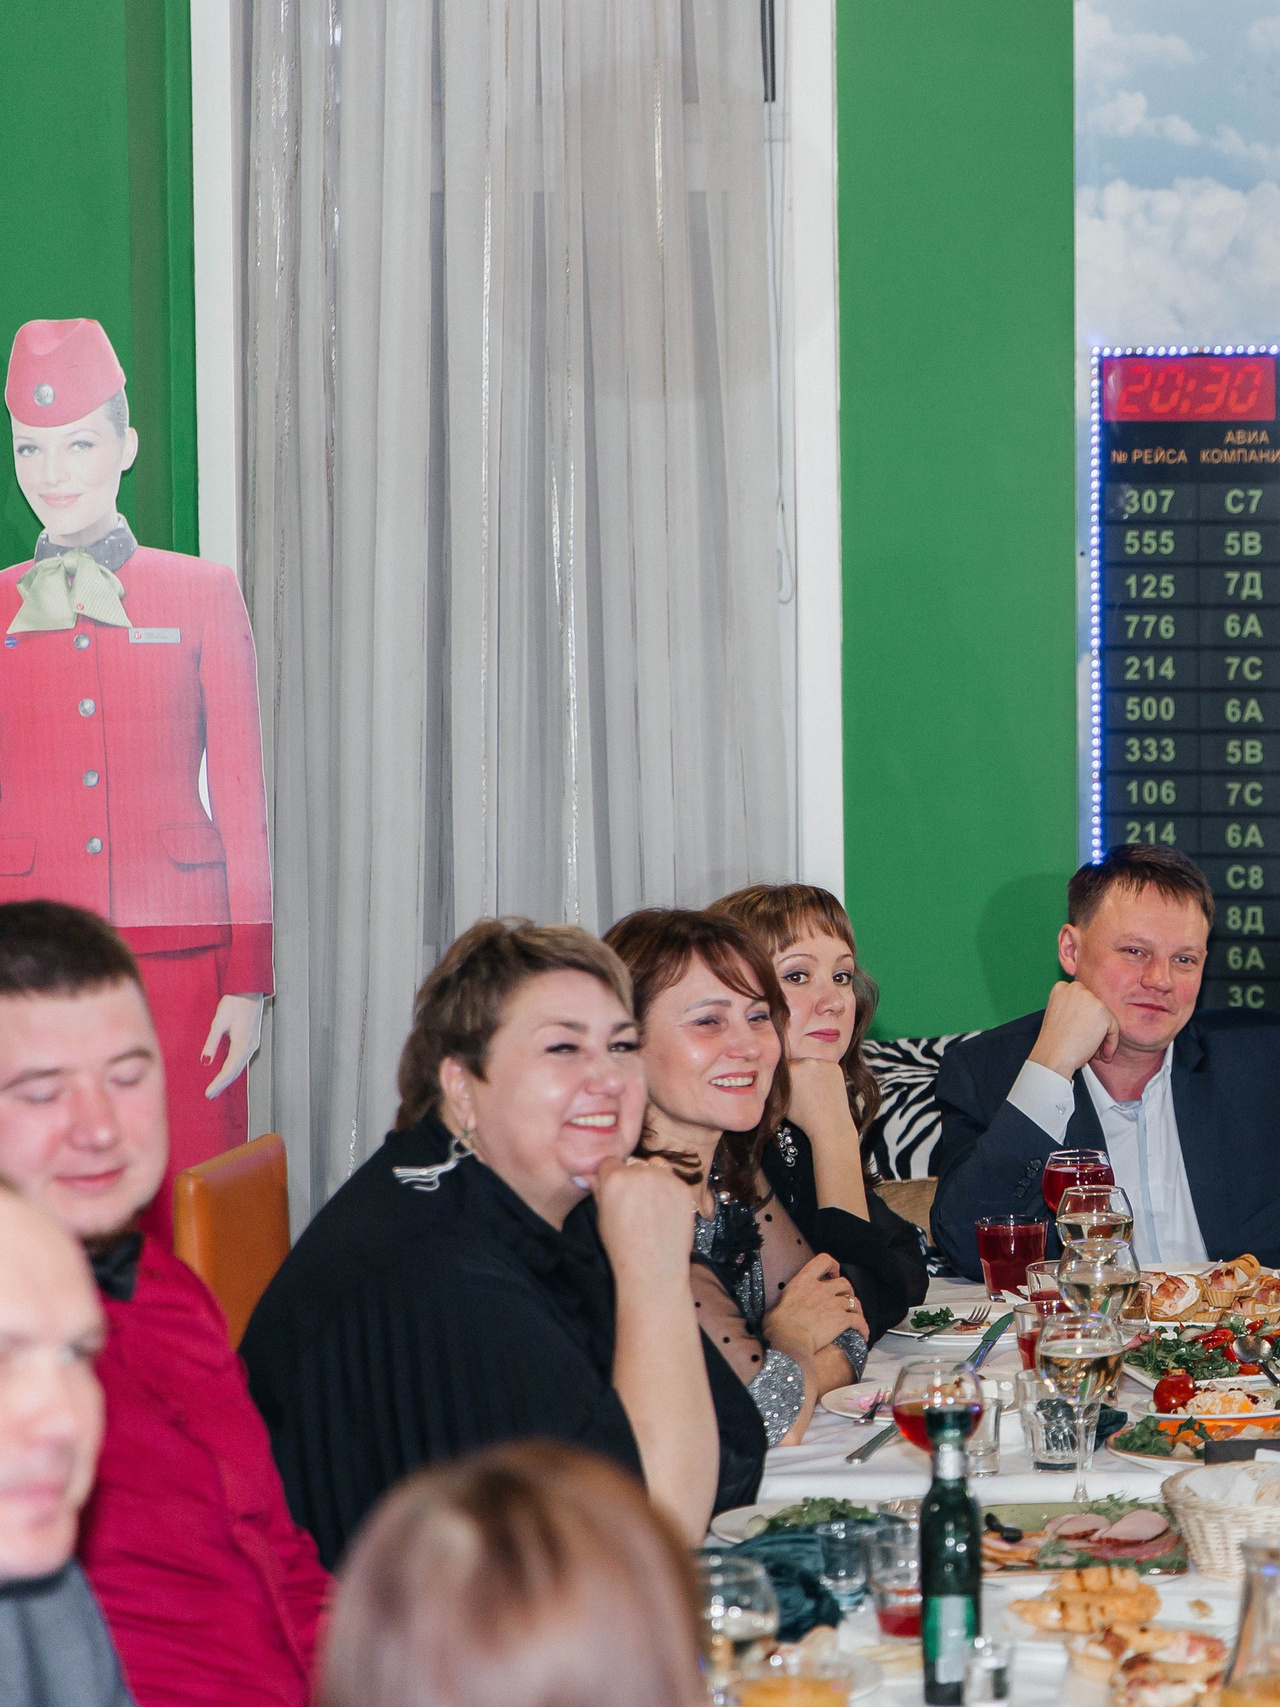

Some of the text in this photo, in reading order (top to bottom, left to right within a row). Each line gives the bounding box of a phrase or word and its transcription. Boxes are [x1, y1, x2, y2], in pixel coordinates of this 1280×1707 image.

[1115, 363, 1265, 415] 20:30
[1223, 429, 1270, 446] АВИА
[1110, 446, 1189, 464] № РЕЙСА
[1124, 488, 1175, 514] 307
[1224, 488, 1263, 514] С7
[1124, 530, 1175, 555] 555
[1225, 531, 1262, 556] 5В
[1125, 574, 1175, 599] 125
[1224, 571, 1263, 600] 7Д
[1124, 614, 1175, 639] 776
[1224, 613, 1263, 638] 6А
[1124, 656, 1176, 681] 214
[1225, 656, 1263, 681] 7С
[1125, 696, 1175, 721] 500
[1225, 698, 1264, 723] 6А
[1125, 737, 1176, 762] 333
[1226, 739, 1264, 764] 5В
[1126, 780, 1176, 805] 106
[1226, 781, 1263, 807] 7С
[1125, 821, 1176, 845] 214
[1225, 823, 1264, 848] 6А
[1226, 864, 1264, 890] С8
[1226, 905, 1265, 934] 8Д
[1227, 945, 1265, 970] 6А
[1228, 984, 1265, 1009] 3С
